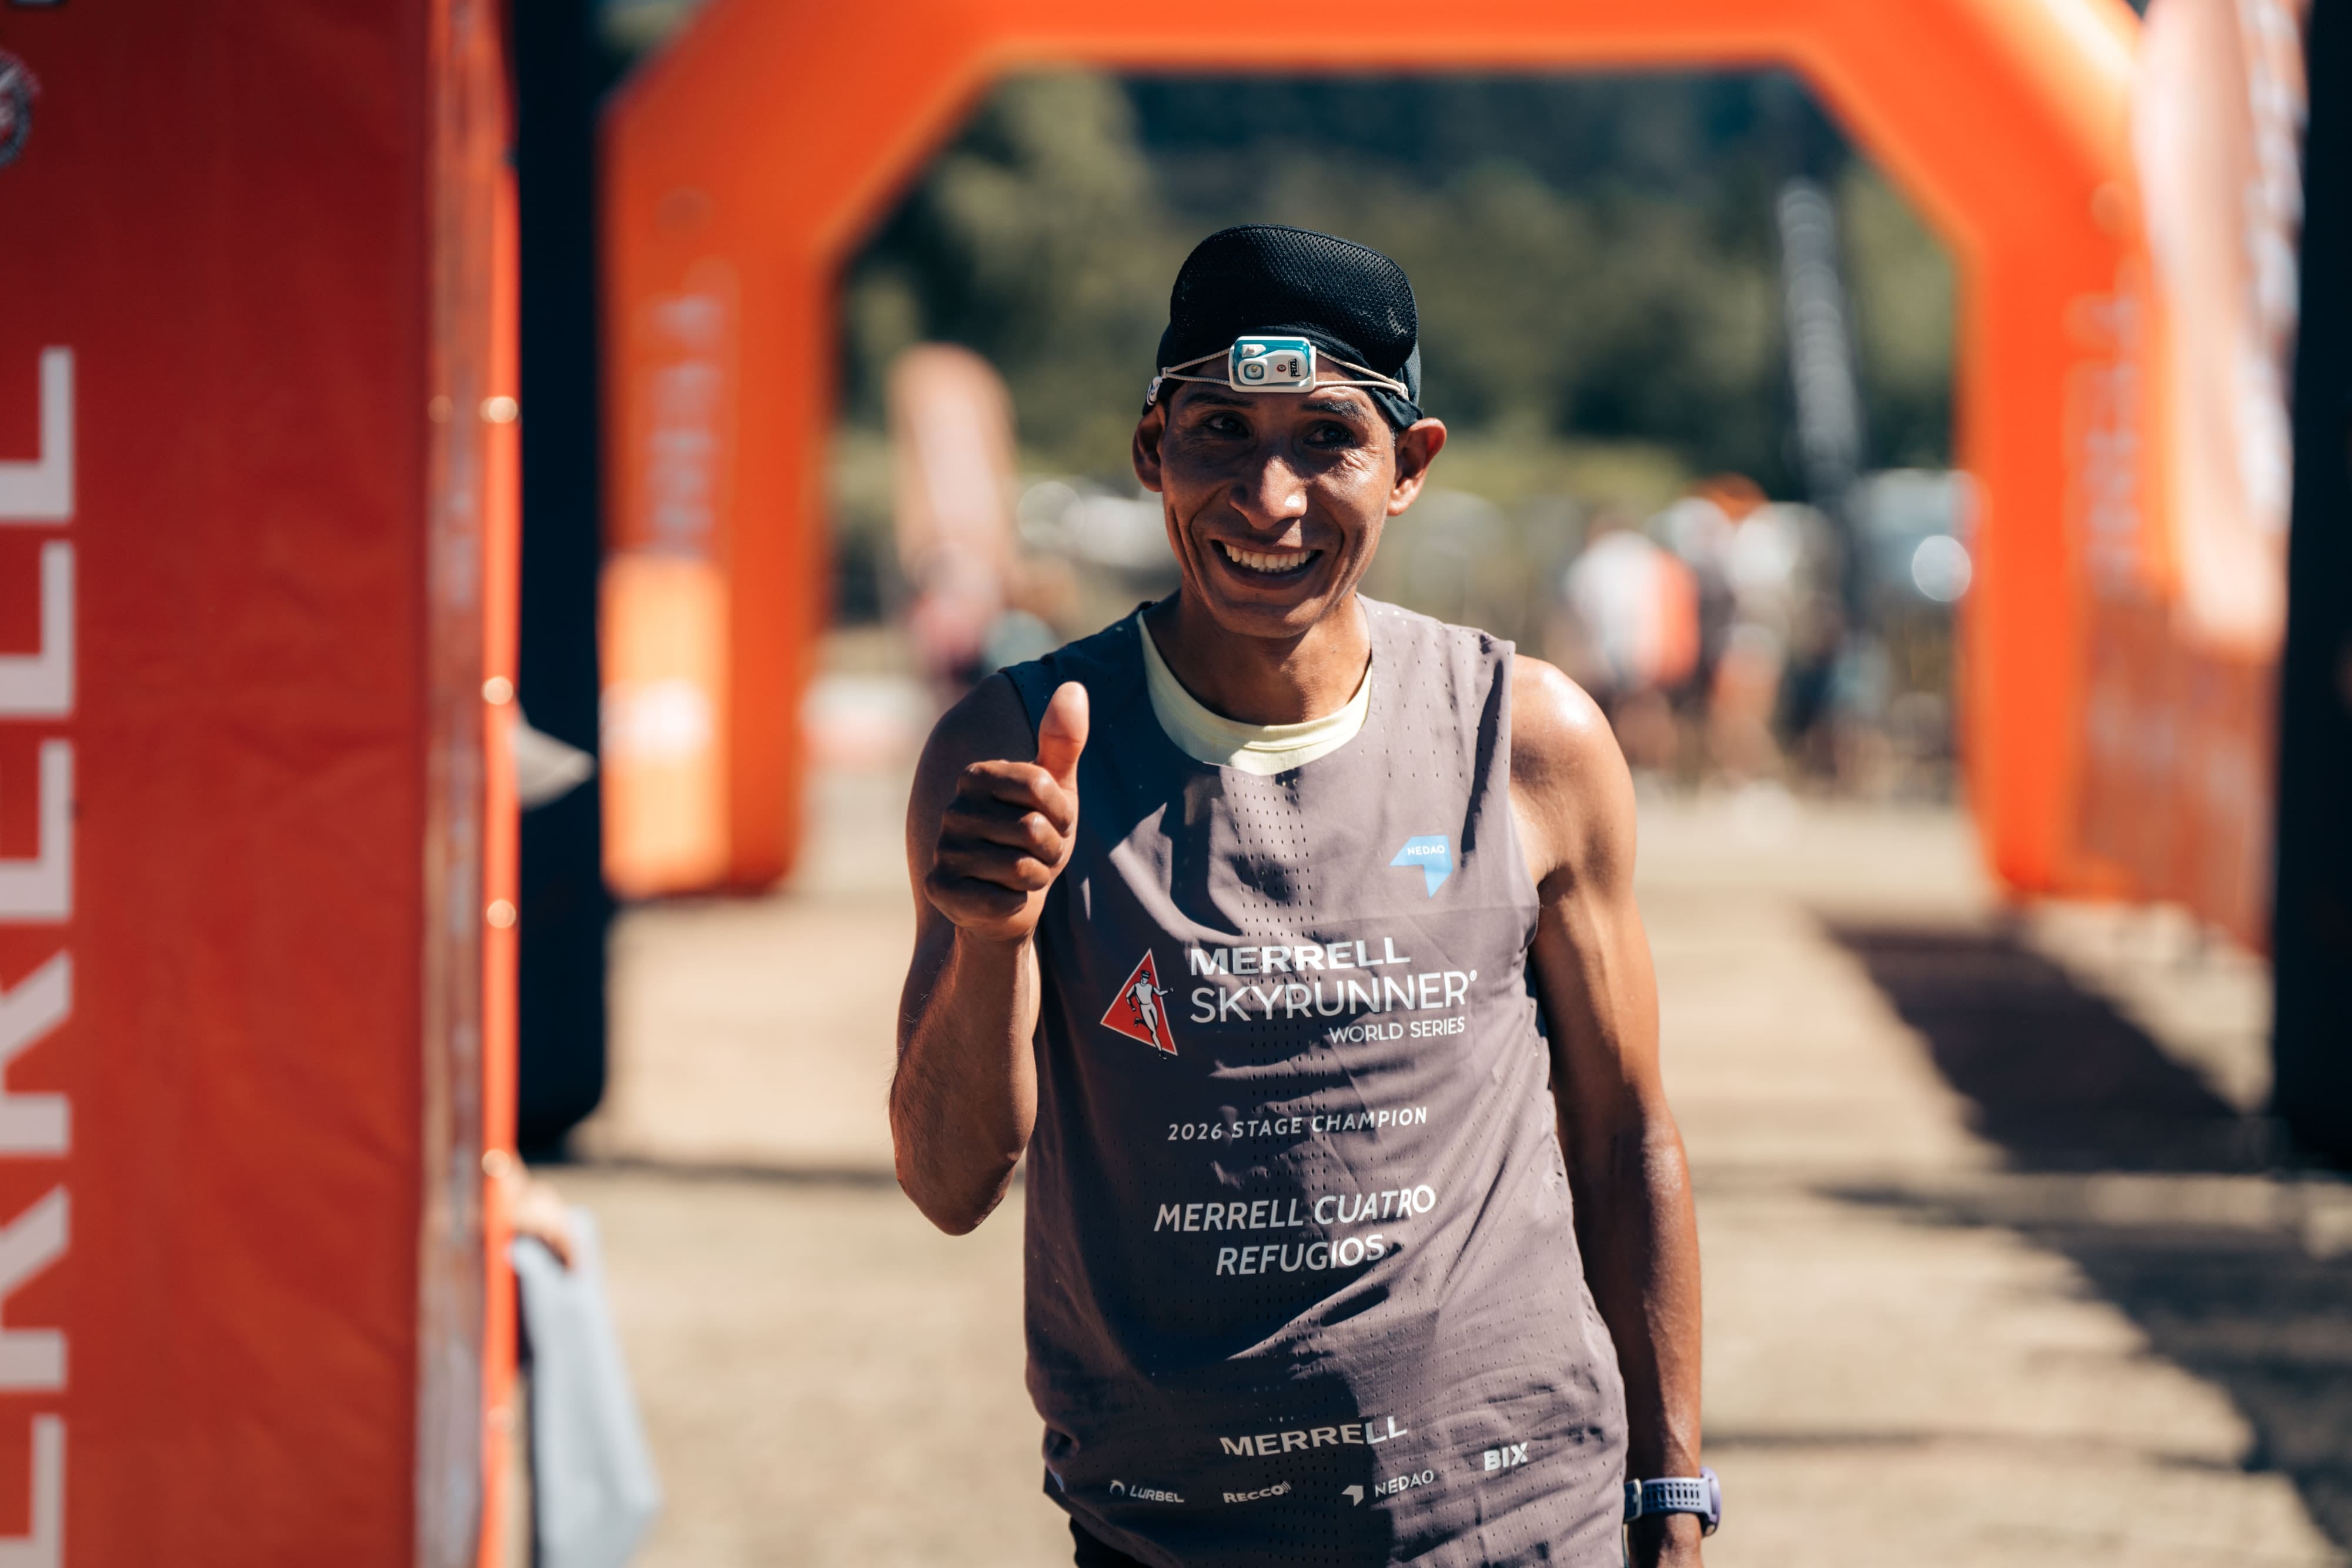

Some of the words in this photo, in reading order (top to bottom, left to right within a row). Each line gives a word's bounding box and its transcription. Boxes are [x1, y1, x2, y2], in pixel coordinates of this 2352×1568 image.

[1290, 358, 1301, 377] PETZL
[1407, 845, 1445, 855] NEDAO
[1191, 937, 1411, 976] MERRELL
[1329, 1022, 1404, 1044] WORLD
[1411, 1016, 1465, 1038] SERIES
[1168, 1123, 1222, 1141] 2026
[1232, 1118, 1302, 1138] STAGE
[1312, 1106, 1427, 1132] CHAMPION
[1154, 1198, 1304, 1232] MERRELL
[1314, 1185, 1436, 1225] CUATRO
[1216, 1234, 1385, 1276] REFUGIOS
[1219, 1415, 1408, 1457] MERRELL
[1484, 1442, 1529, 1472] BIX
[1129, 1485, 1185, 1503] LURBEL
[1222, 1485, 1285, 1503] RECCO
[1374, 1470, 1434, 1497] NEDAO
